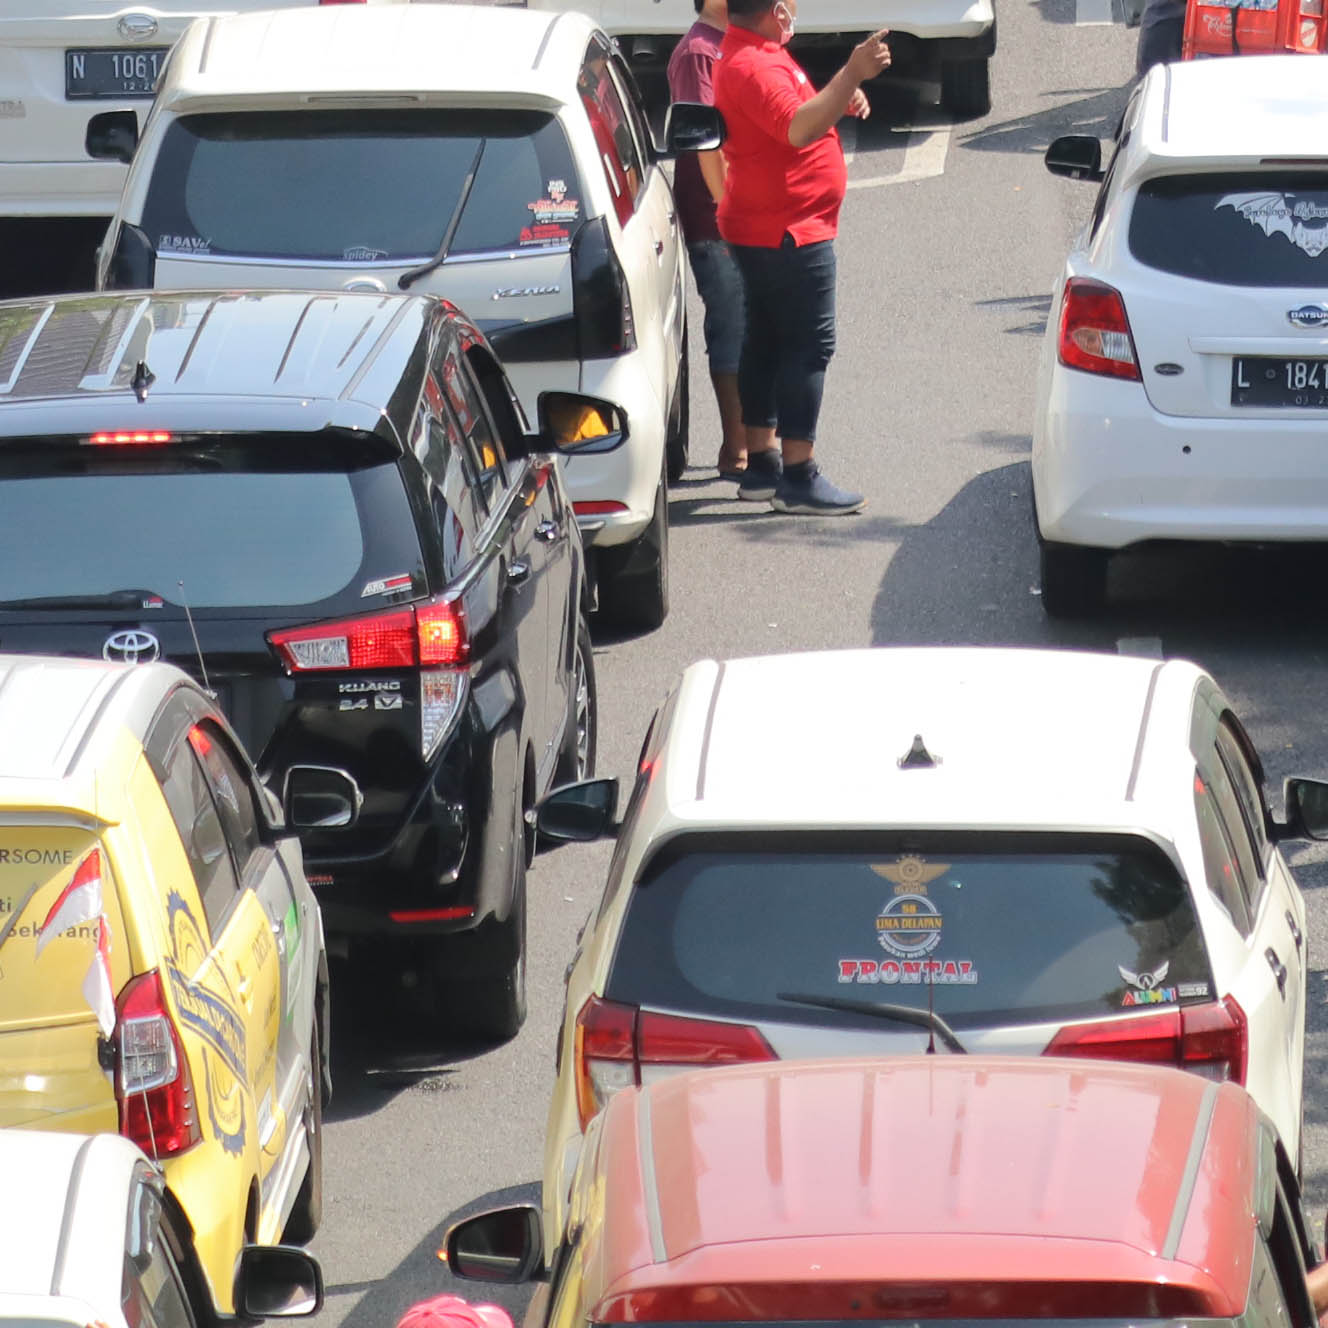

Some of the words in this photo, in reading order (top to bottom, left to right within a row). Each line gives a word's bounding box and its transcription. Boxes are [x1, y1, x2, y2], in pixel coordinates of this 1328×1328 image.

[73, 55, 87, 80] N
[113, 54, 160, 80] 1061
[1238, 361, 1250, 389] L
[877, 917, 900, 929] LIMA
[902, 916, 944, 929] DELAPAN
[838, 959, 978, 985] FRONTAL
